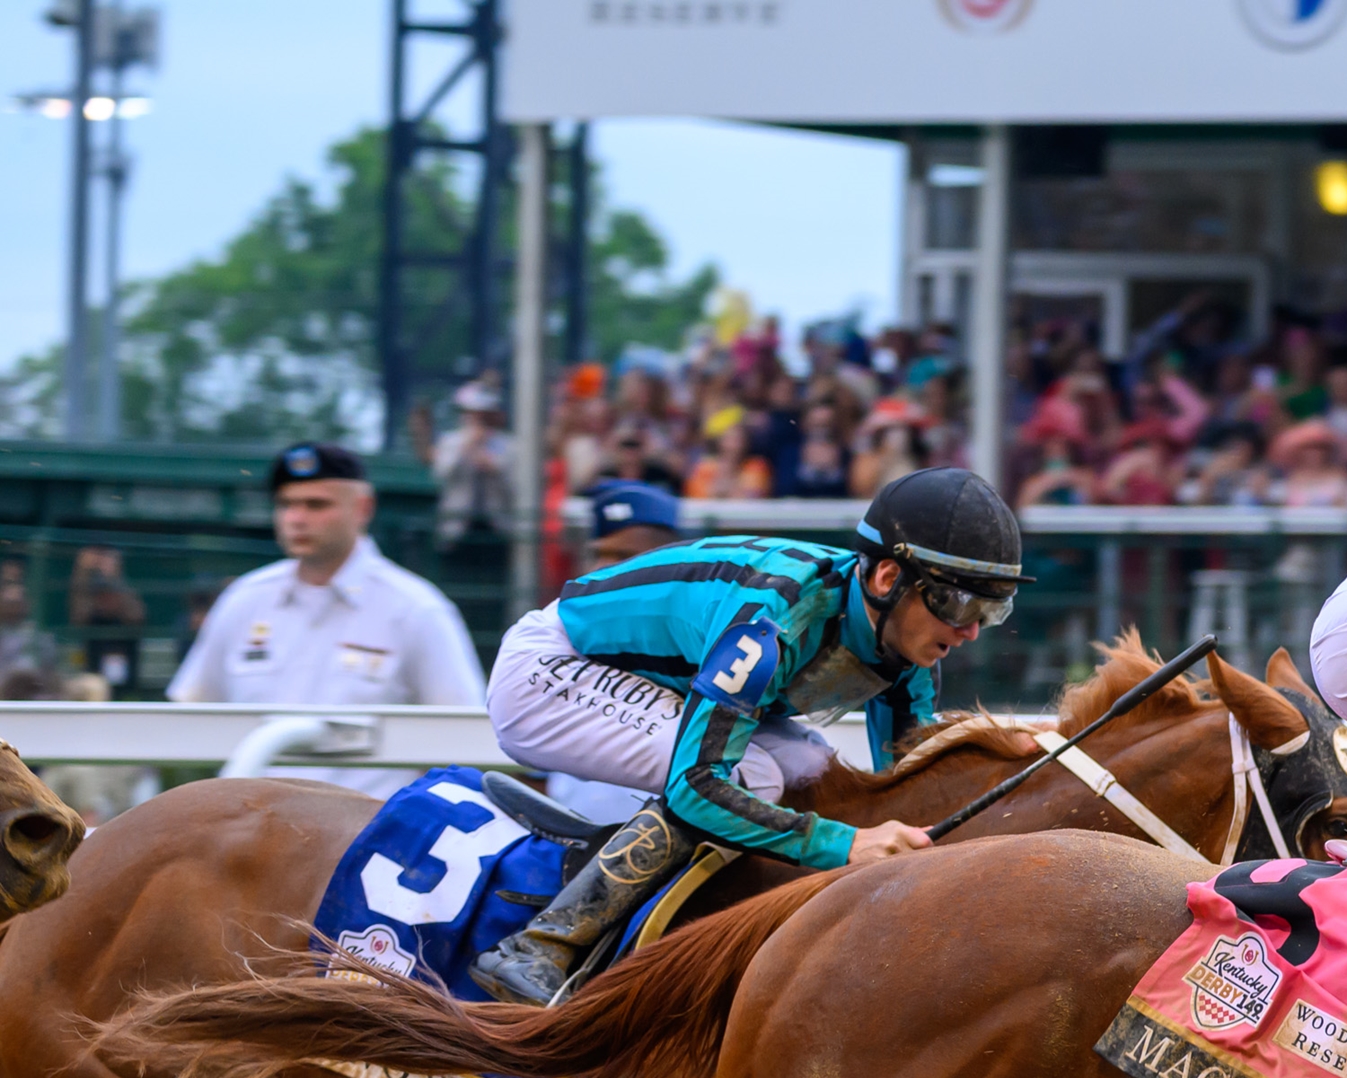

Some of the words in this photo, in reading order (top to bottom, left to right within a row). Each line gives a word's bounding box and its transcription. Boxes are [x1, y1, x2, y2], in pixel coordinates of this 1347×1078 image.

[712, 634, 762, 694] 3
[527, 671, 655, 736] STAKHOUSE
[360, 781, 532, 926] 3
[1189, 967, 1243, 1007] DERBY
[1236, 993, 1265, 1021] 149
[1213, 952, 1269, 998] Kentucky
